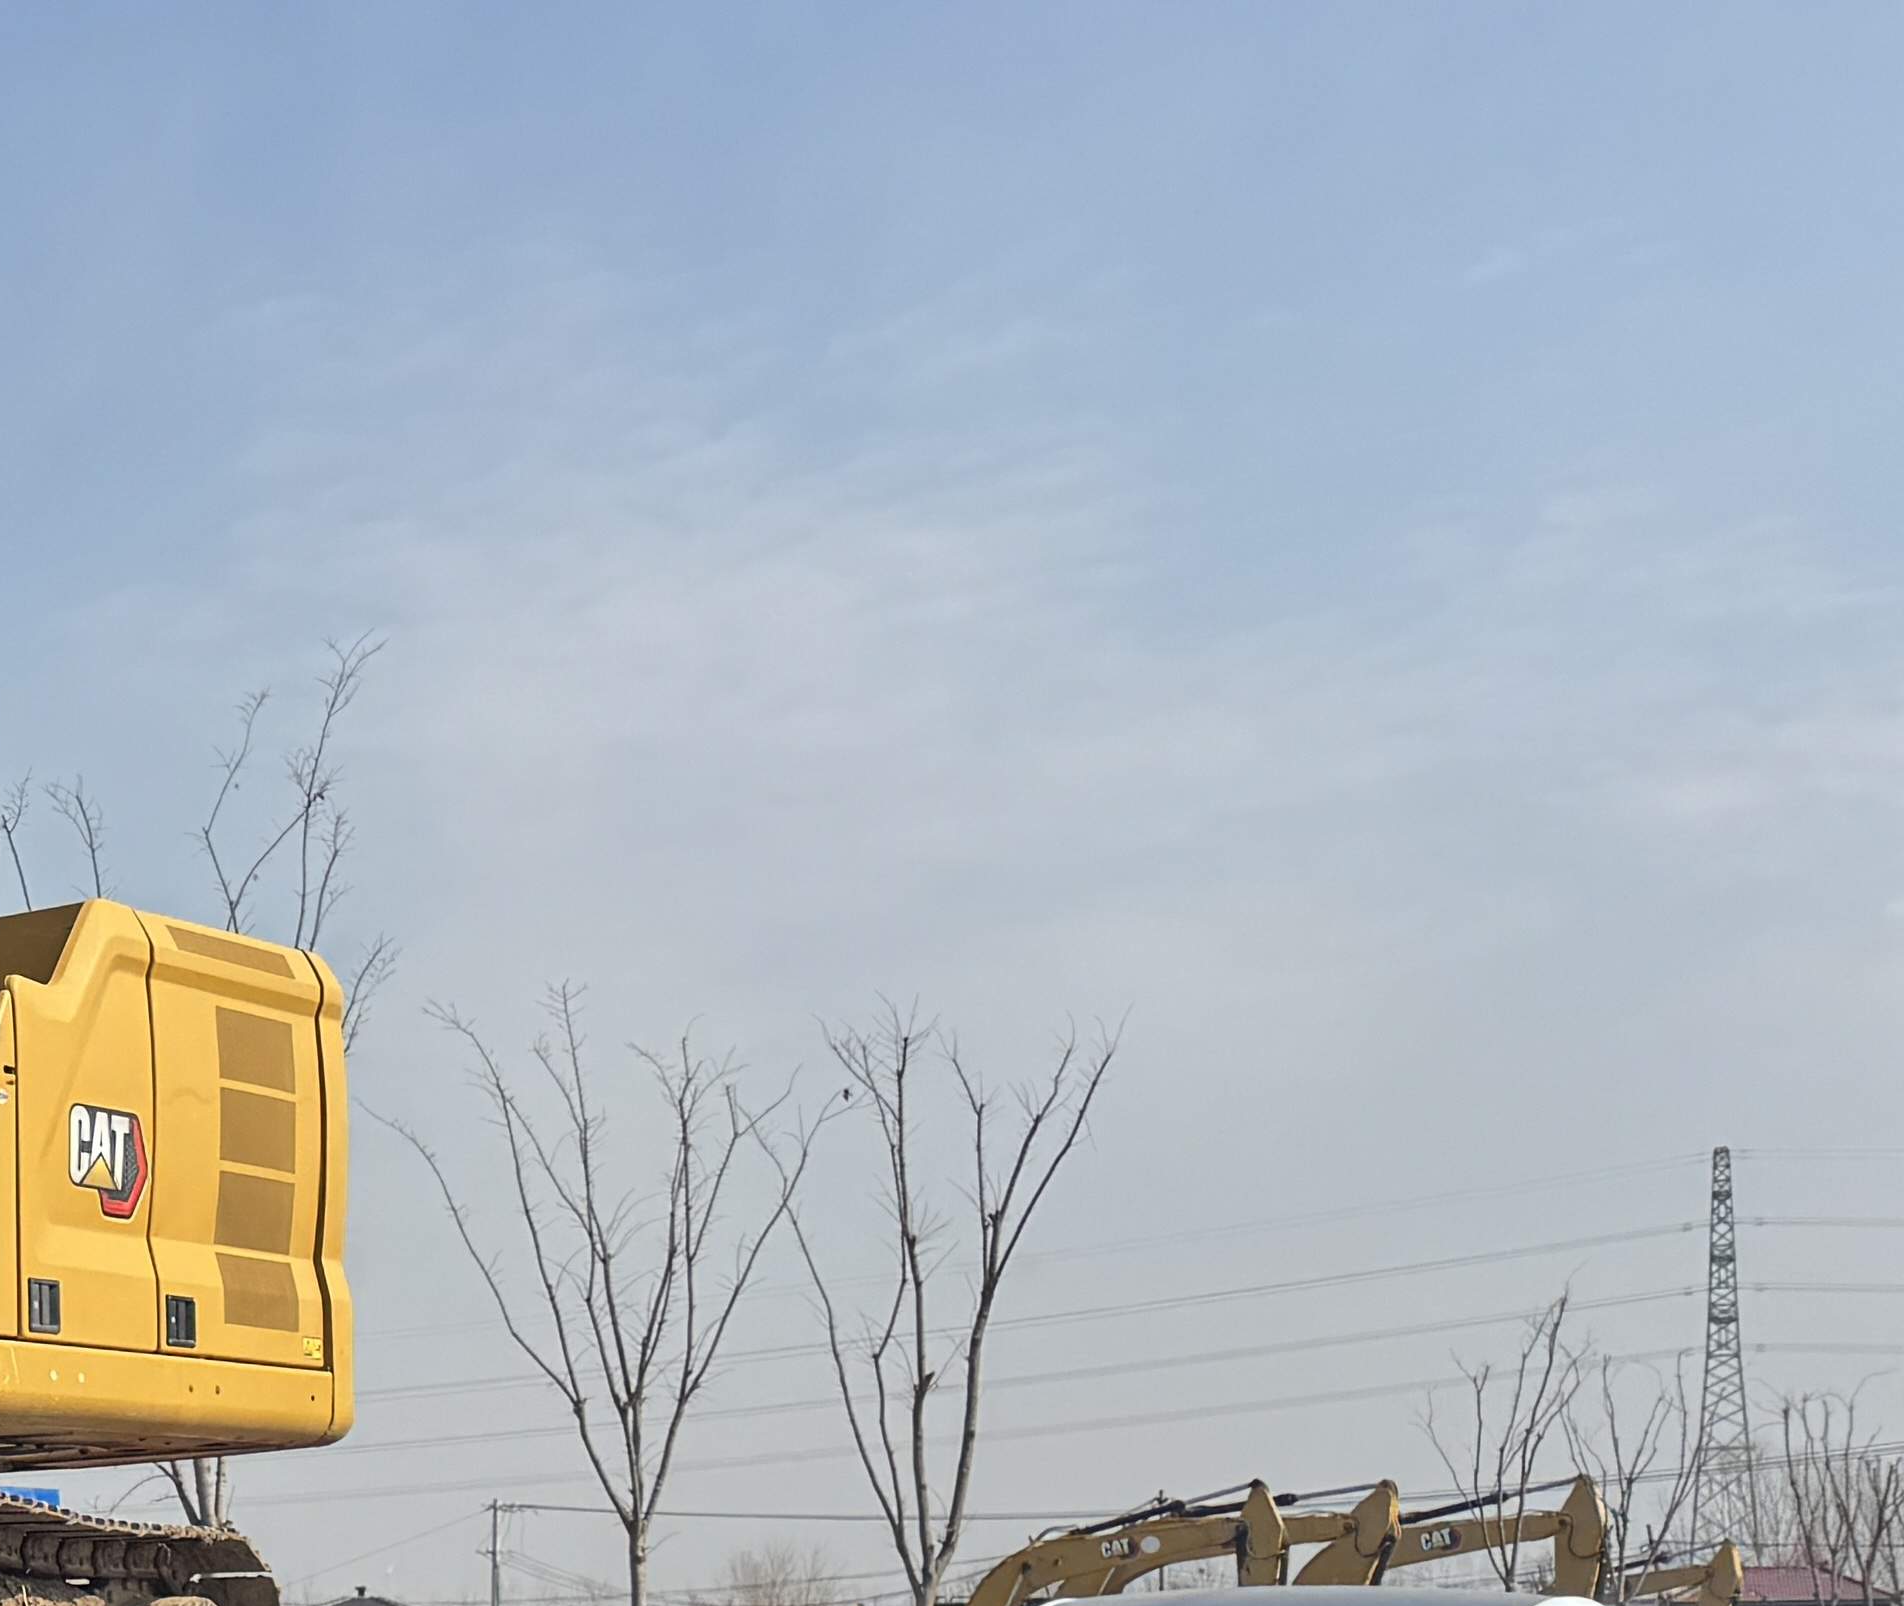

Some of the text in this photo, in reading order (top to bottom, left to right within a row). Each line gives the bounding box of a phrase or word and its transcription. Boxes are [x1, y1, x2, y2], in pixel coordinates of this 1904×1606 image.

[70, 1105, 130, 1191] CAT
[1100, 1538, 1130, 1559] CAT
[1421, 1528, 1451, 1552] CAT
